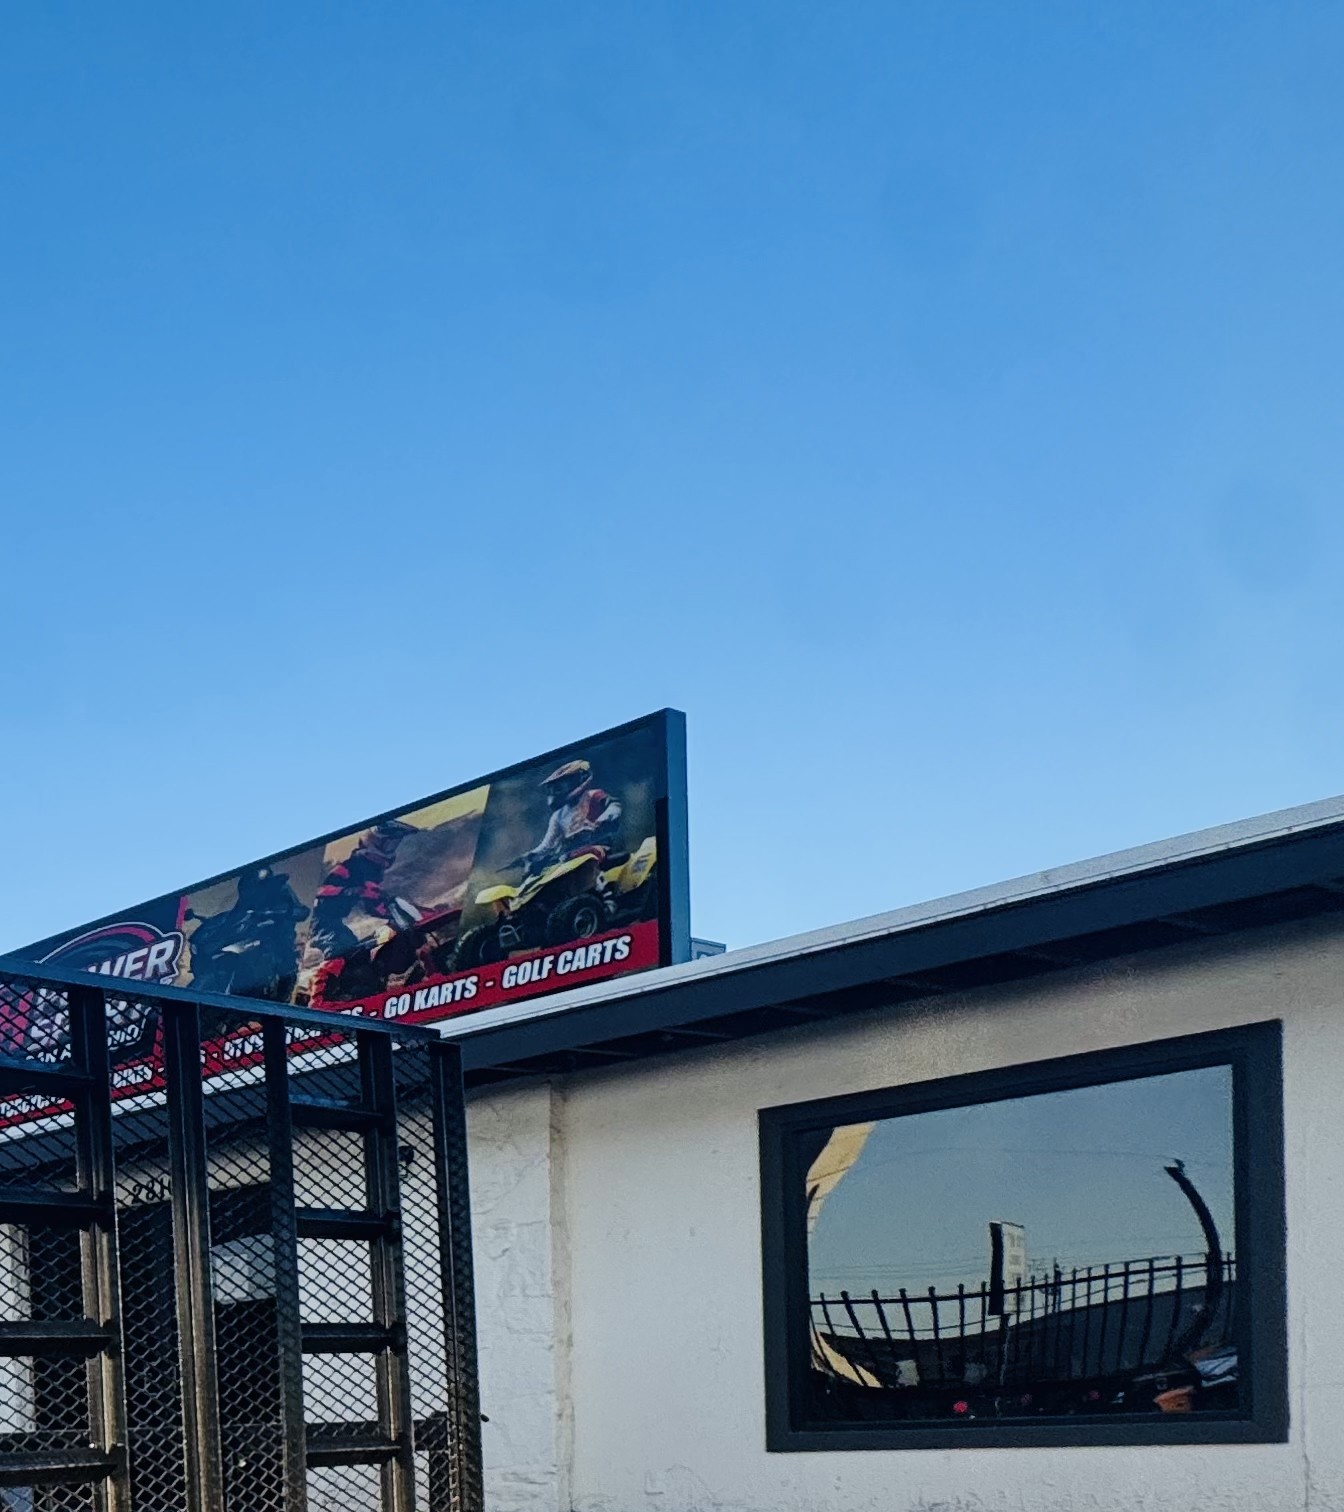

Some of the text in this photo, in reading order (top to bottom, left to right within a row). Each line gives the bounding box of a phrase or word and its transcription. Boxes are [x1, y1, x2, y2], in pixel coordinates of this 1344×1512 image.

[384, 993, 411, 1019] GO
[413, 975, 479, 1013] KARTS
[502, 961, 554, 989] GOLF
[557, 935, 632, 975] CARTS
